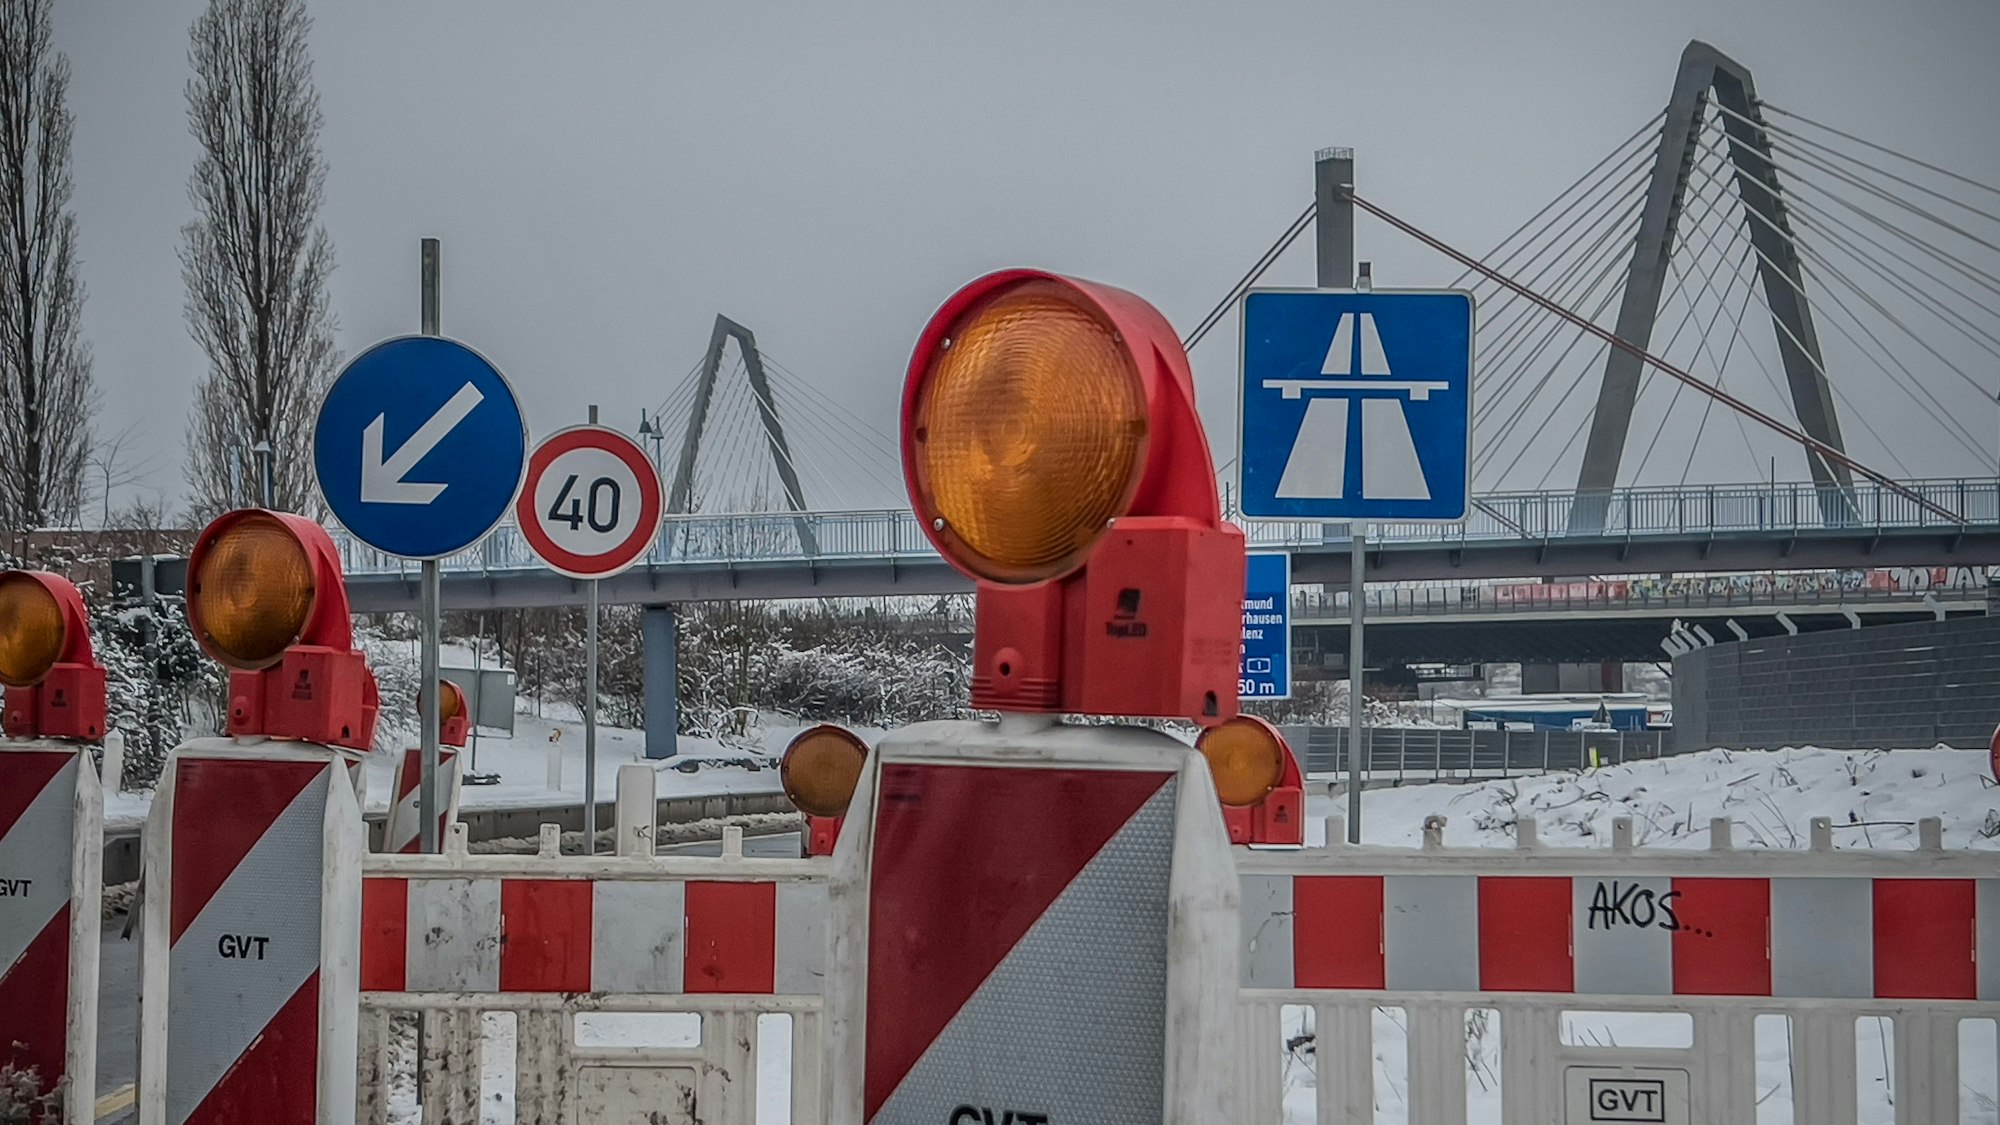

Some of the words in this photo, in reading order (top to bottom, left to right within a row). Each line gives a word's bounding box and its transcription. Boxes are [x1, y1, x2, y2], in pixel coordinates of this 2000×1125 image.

[548, 474, 621, 534] 40
[1241, 612, 1282, 625] rhausen
[1241, 626, 1264, 640] lenz
[1259, 682, 1275, 694] m
[0, 878, 32, 897] GVT
[218, 933, 270, 960] GVT
[1598, 1088, 1659, 1112] GVT
